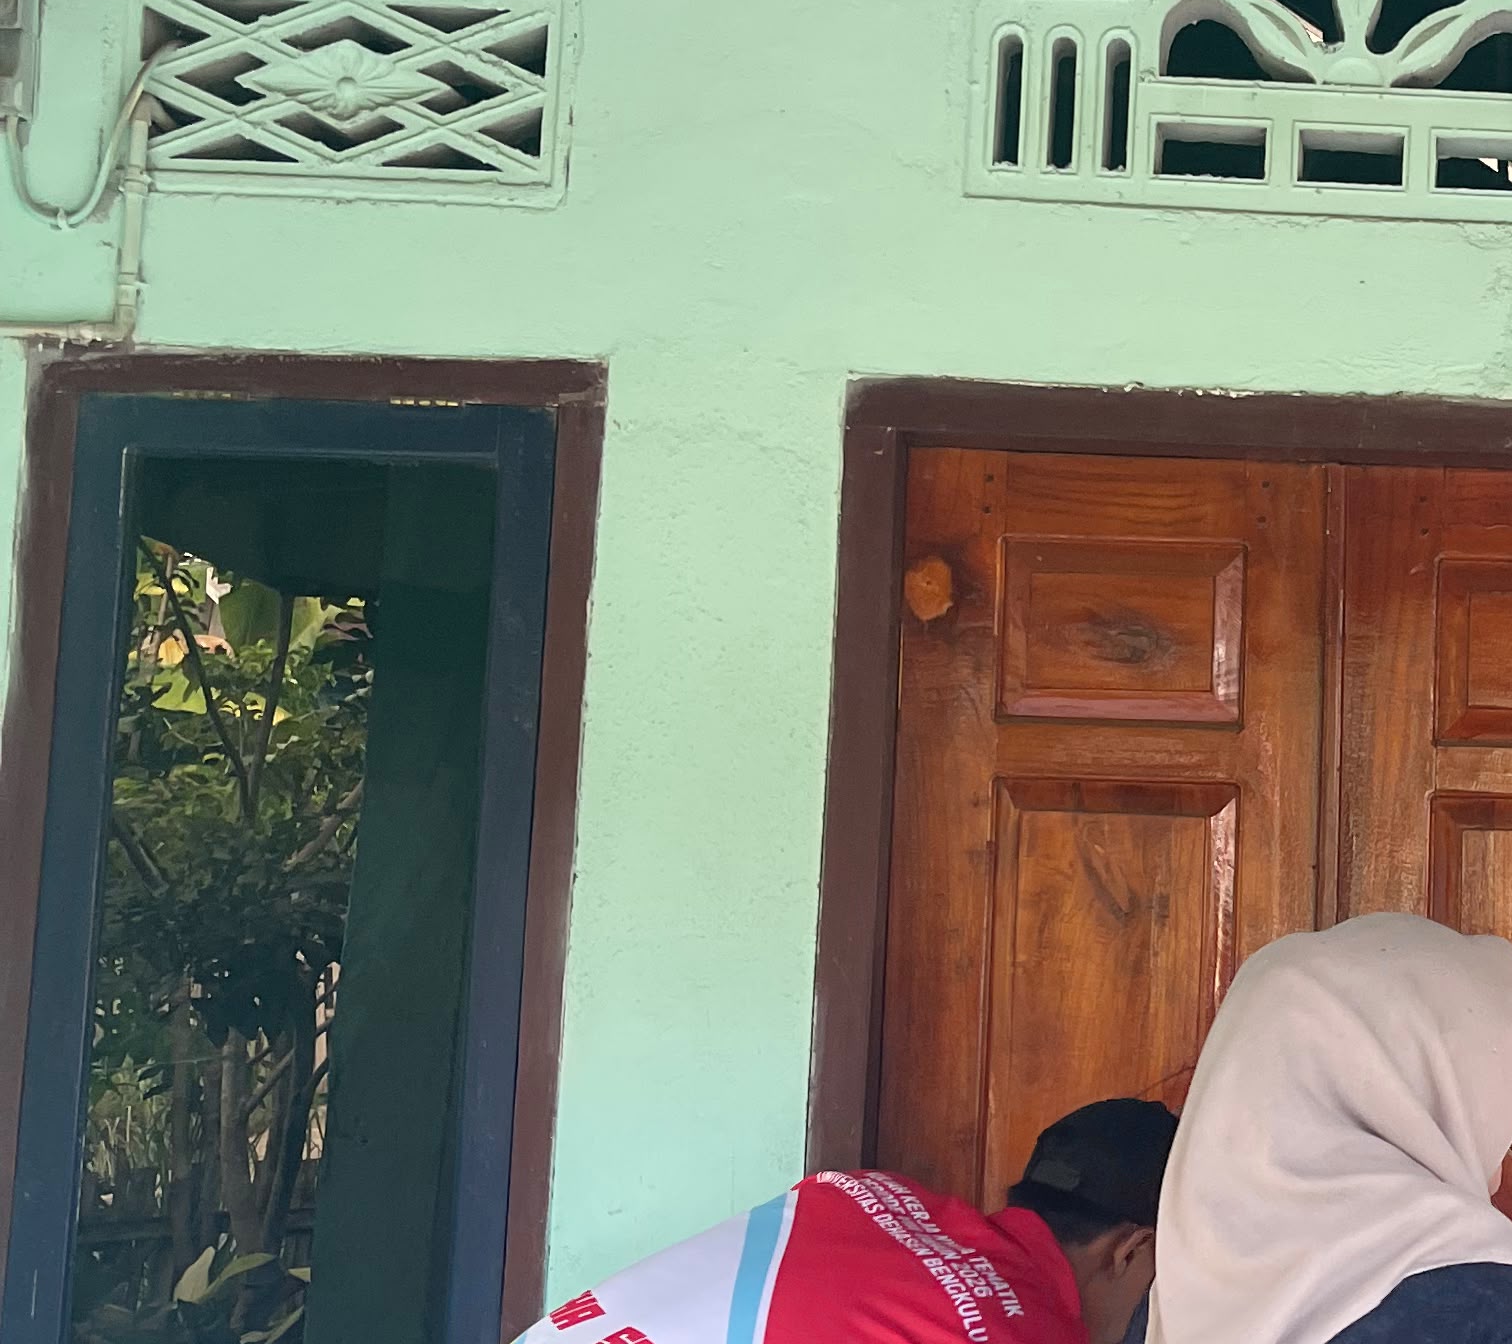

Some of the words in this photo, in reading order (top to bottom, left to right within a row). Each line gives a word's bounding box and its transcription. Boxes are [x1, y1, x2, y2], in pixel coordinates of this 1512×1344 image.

[922, 1256, 990, 1344] BENGKULU
[950, 1261, 993, 1299] 2026
[968, 1254, 1024, 1318] TEMATIK
